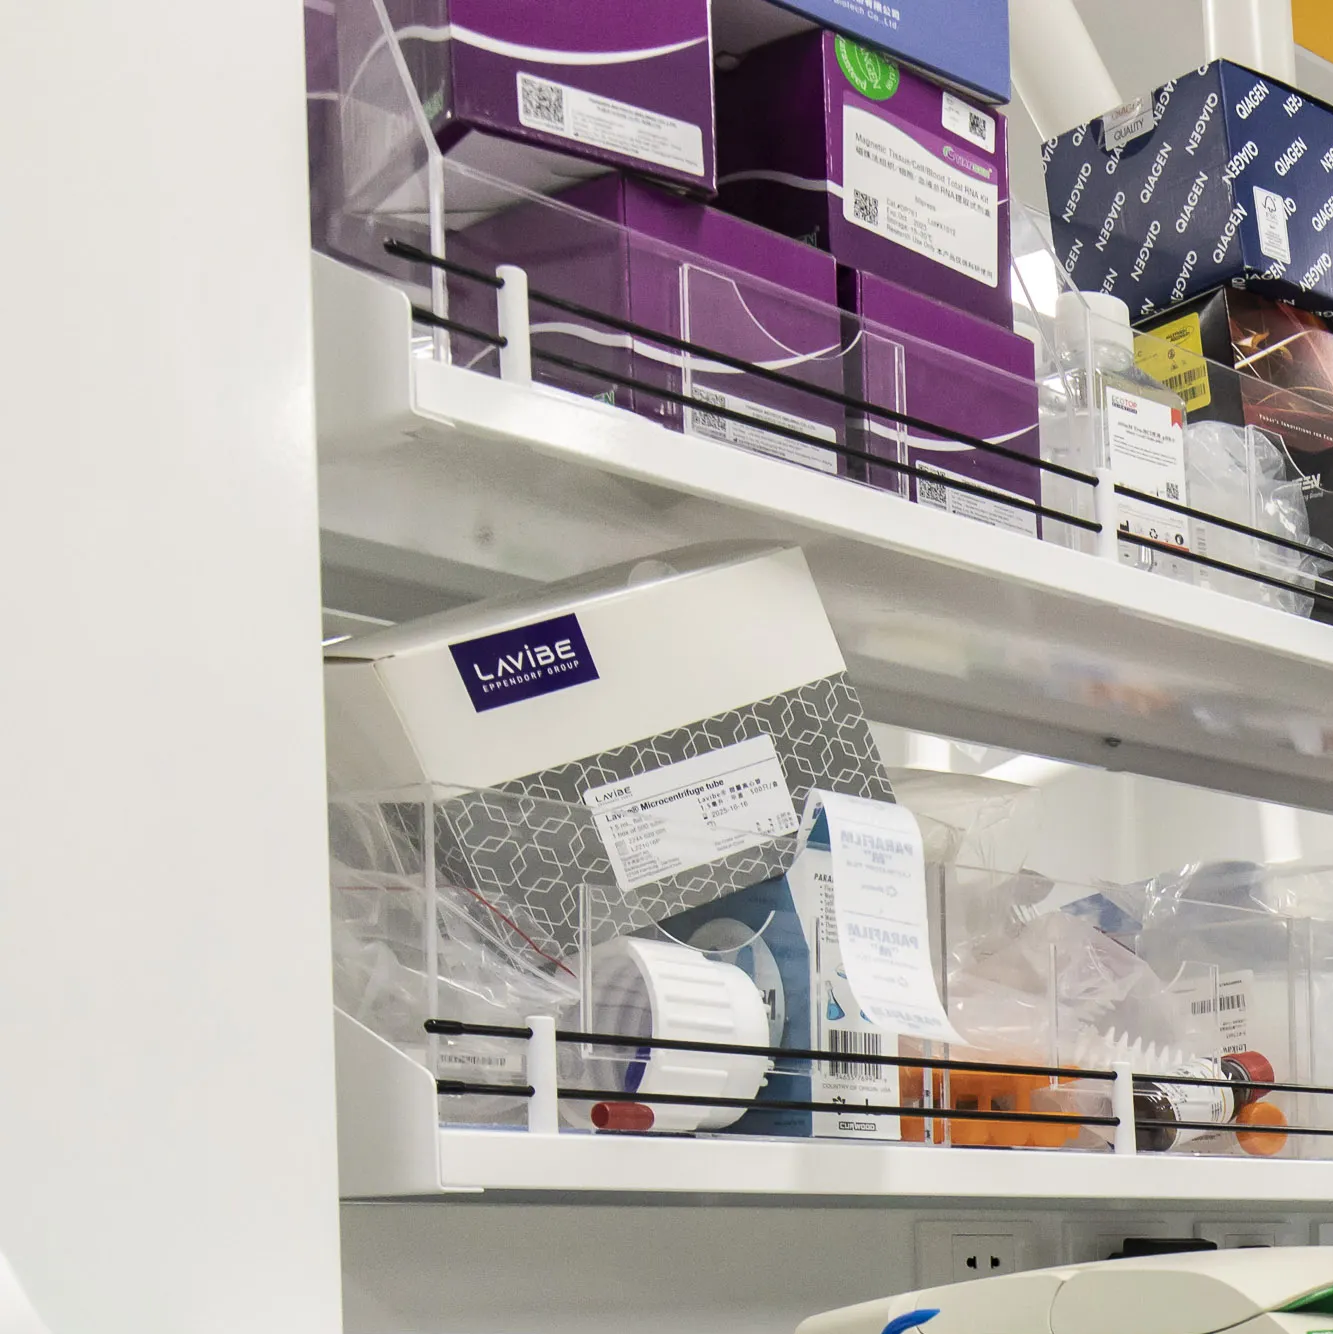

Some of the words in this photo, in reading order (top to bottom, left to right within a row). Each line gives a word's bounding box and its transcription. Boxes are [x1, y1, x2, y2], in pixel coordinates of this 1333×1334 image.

[1235, 80, 1270, 120] QIAGEN
[1113, 119, 1145, 142] QUALITY
[1185, 92, 1219, 156] QIAGEN
[855, 132, 887, 155] Magnetic
[889, 149, 946, 184] Tissue/Cell/Blood
[947, 175, 964, 193] Total
[964, 184, 979, 201] RNA
[980, 192, 989, 205] Kit
[1140, 141, 1172, 204] QIAGEN
[1222, 140, 1259, 186] QIAGEN
[1274, 136, 1308, 177] QIAGEN
[1061, 162, 1092, 223] QIAGEN
[1175, 170, 1209, 233] QIAGEN
[1095, 191, 1126, 252] QIAGEN
[1212, 202, 1248, 264] QIAGEN
[1130, 220, 1161, 282] QIAGEN
[1299, 252, 1332, 293] QIAGEN
[482, 670, 543, 693] EPPENDORF
[547, 660, 580, 676] GROUP
[640, 786, 705, 811] Microcentrifuge
[705, 778, 724, 791] tube
[814, 873, 834, 884] PARA
[822, 1083, 849, 1091] COUNTRY
